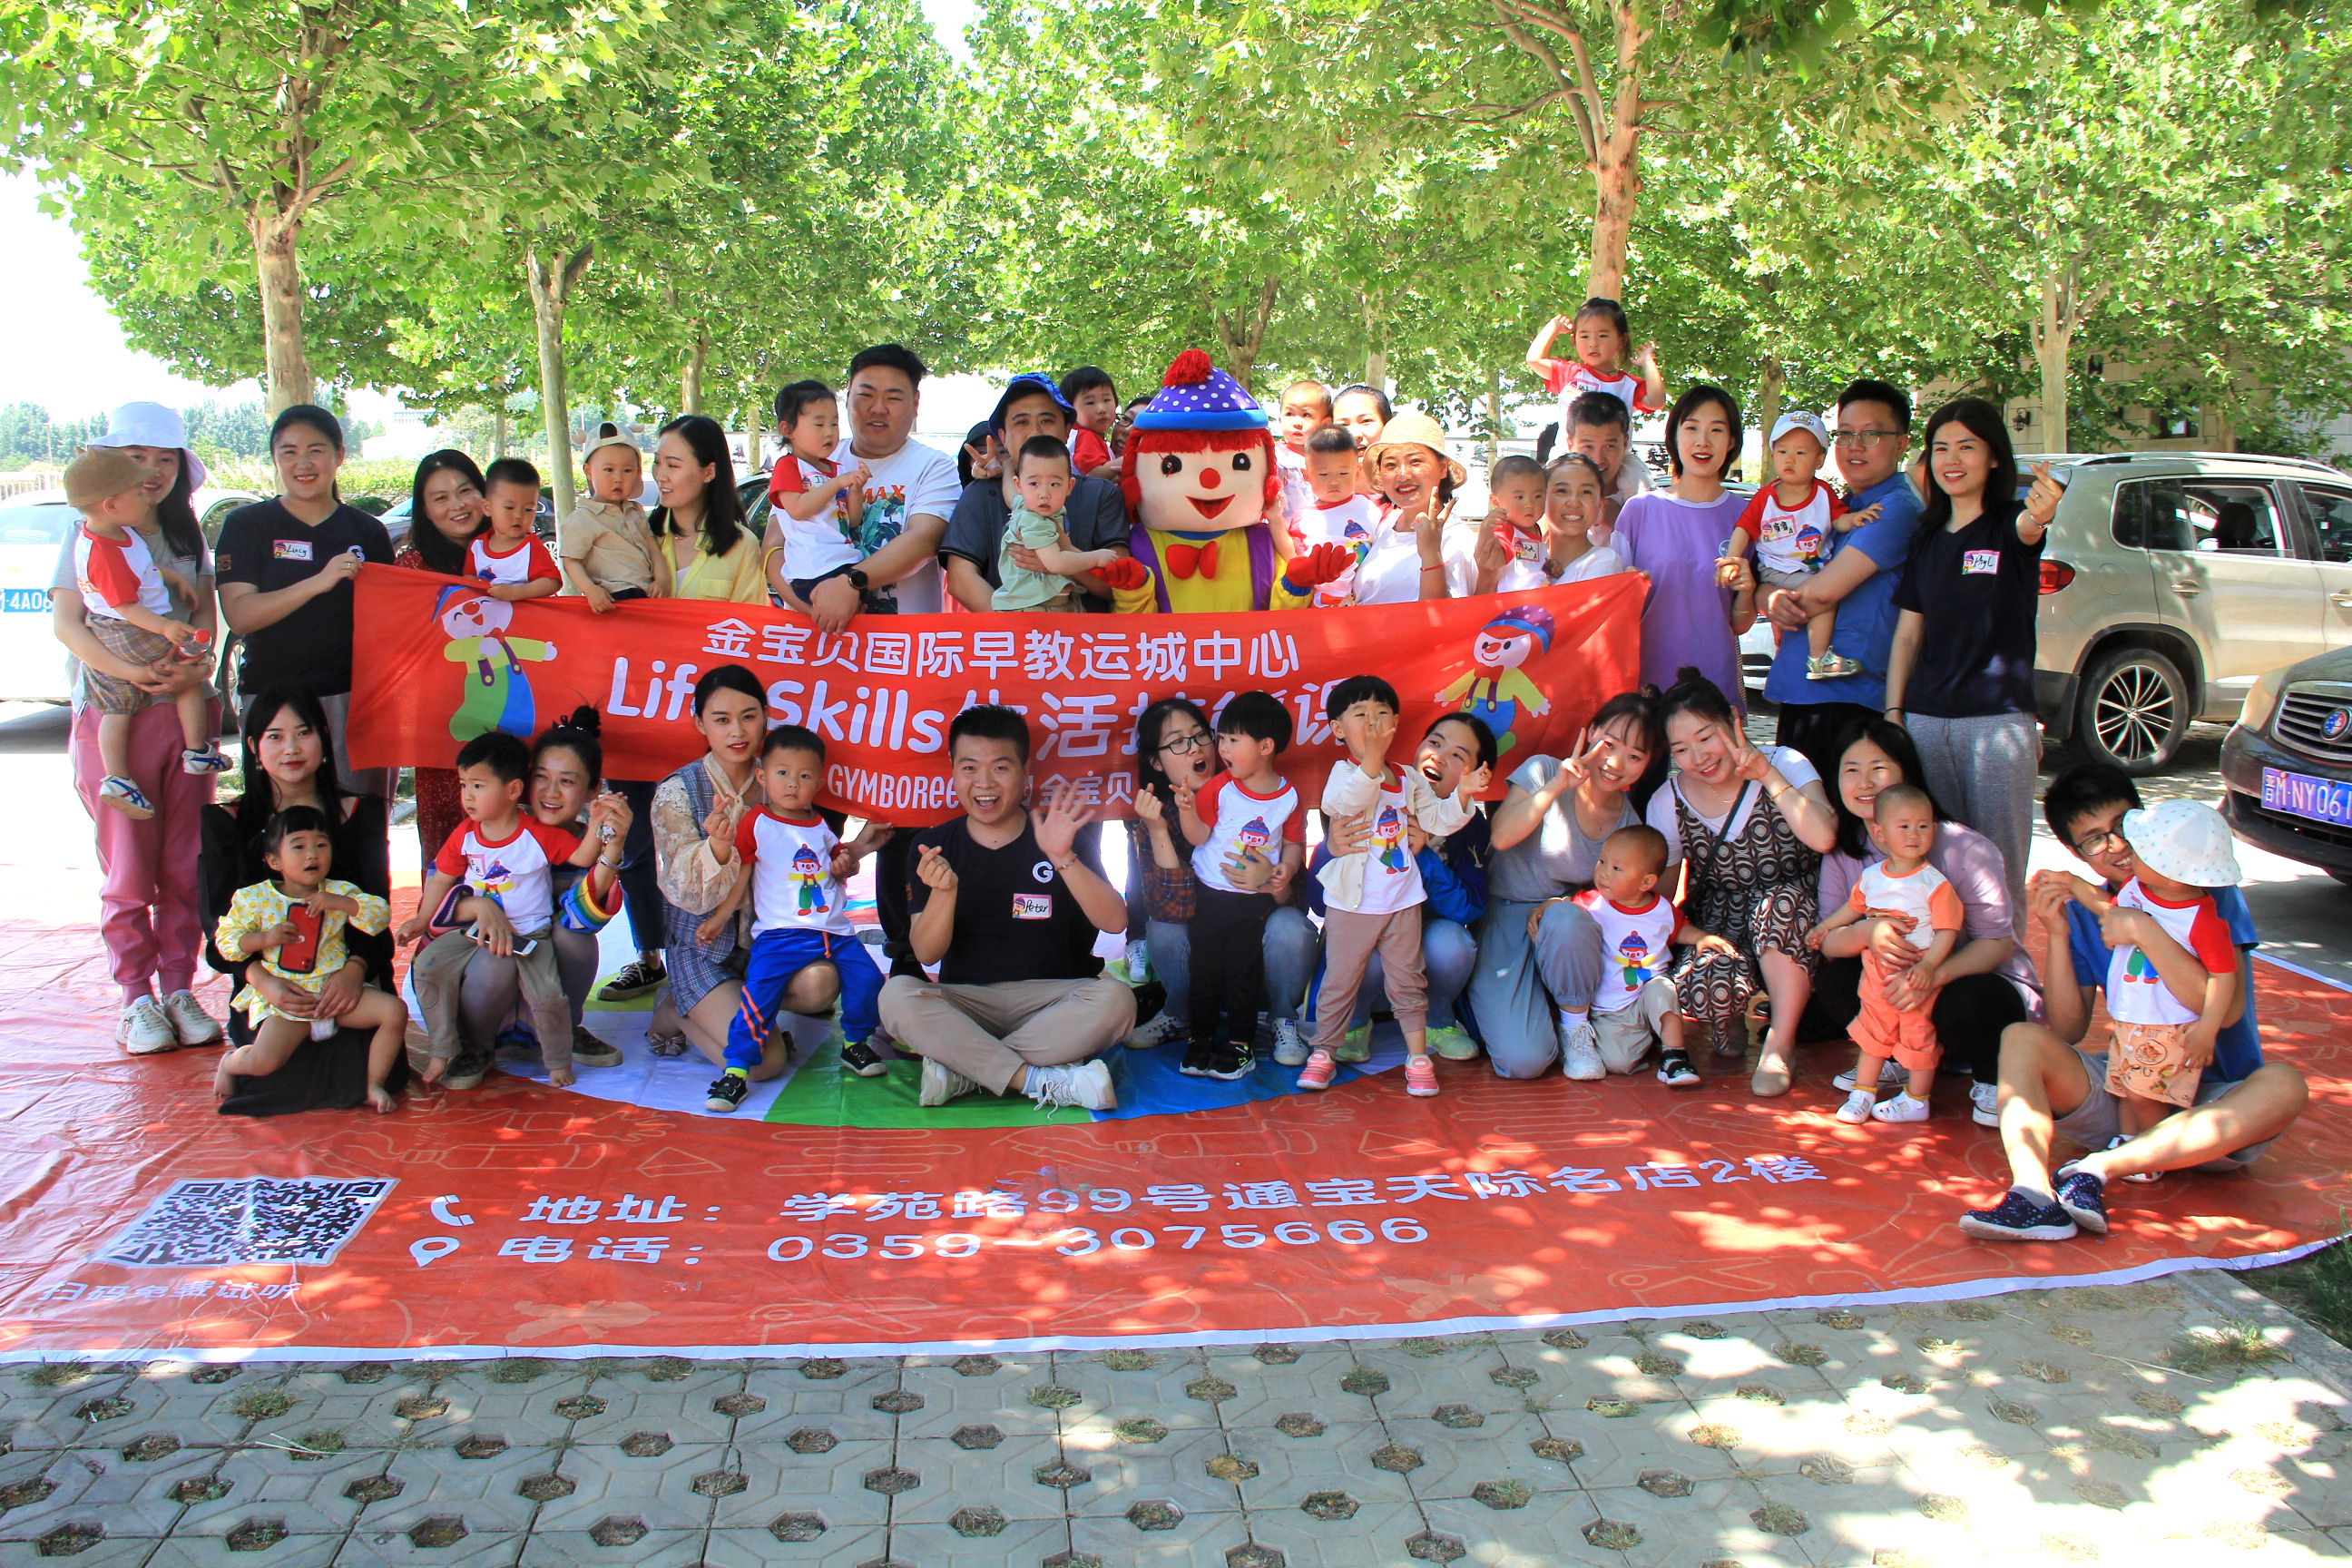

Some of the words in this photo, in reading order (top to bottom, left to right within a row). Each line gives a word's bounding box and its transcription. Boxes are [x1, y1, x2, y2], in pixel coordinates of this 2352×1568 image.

[286, 544, 308, 558] Lucy
[701, 617, 1299, 681] 金宝贝国际早教运城中心
[606, 656, 699, 721] Lif
[767, 680, 946, 754] Skills
[1032, 860, 1054, 884] G
[1024, 898, 1049, 914] Peter
[36, 1279, 303, 1303] 扫码免费试听
